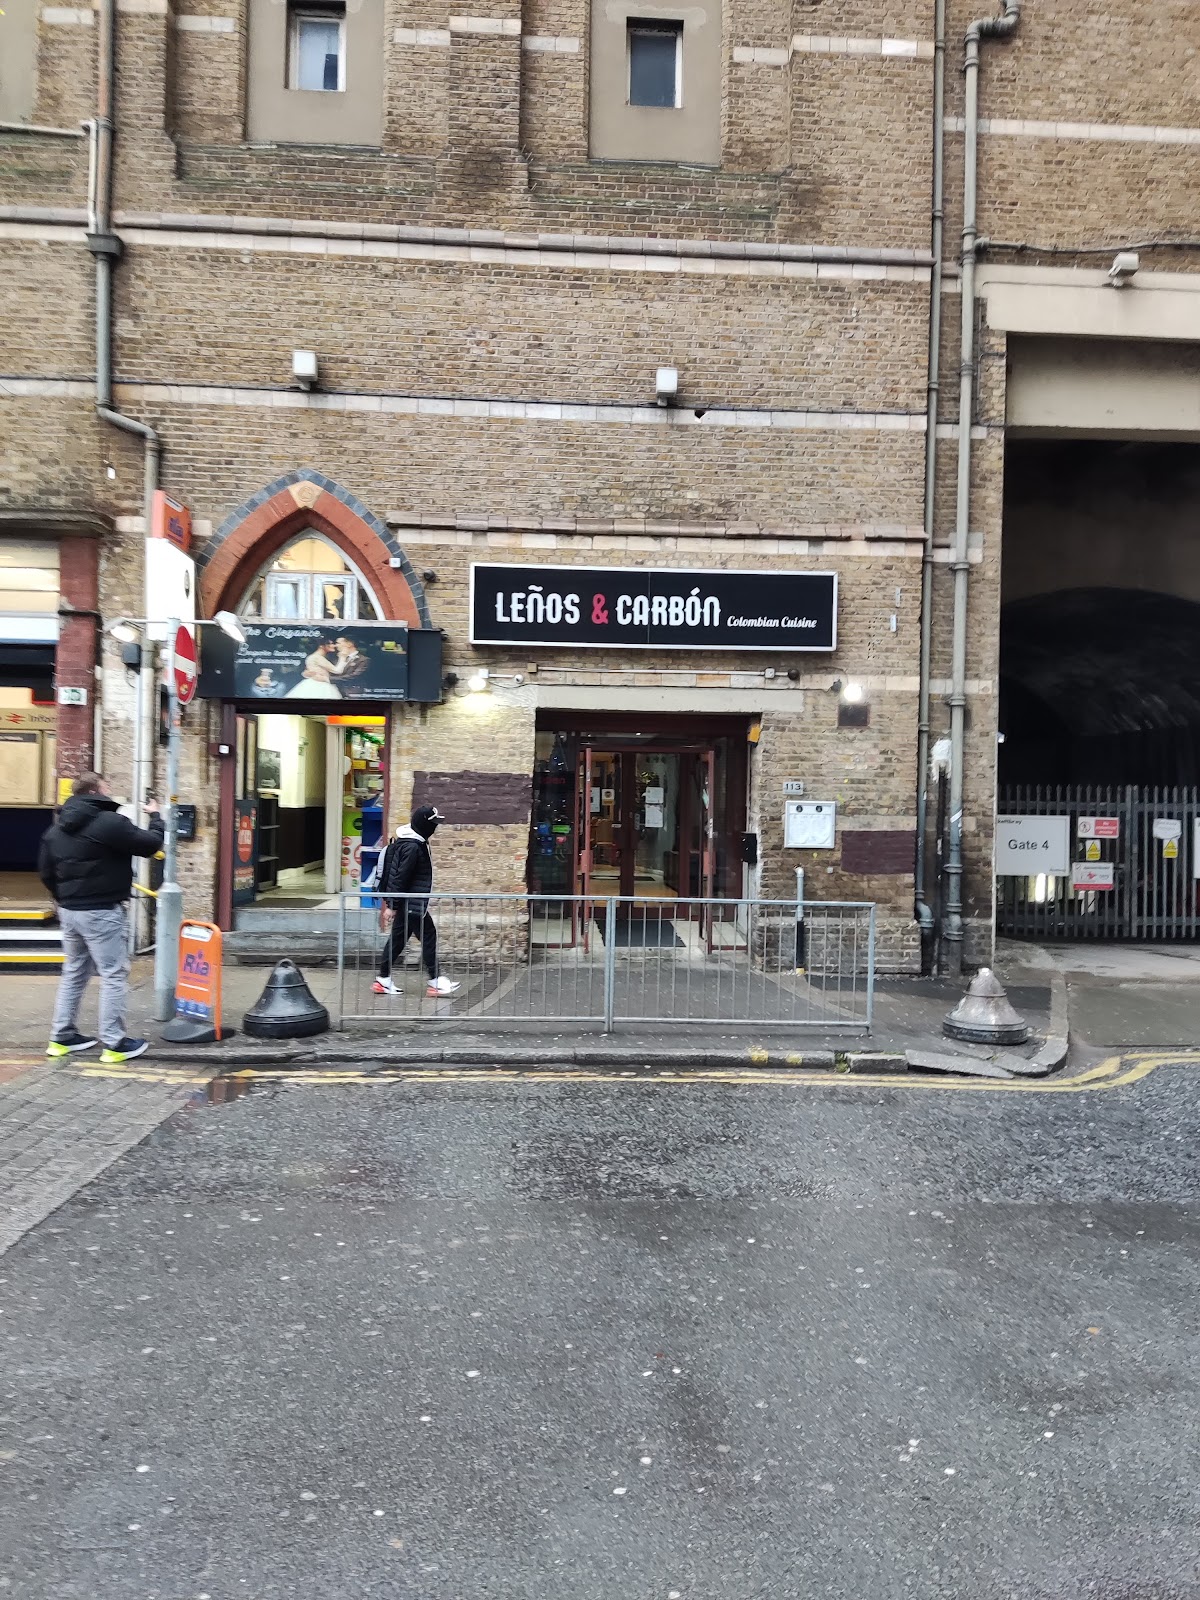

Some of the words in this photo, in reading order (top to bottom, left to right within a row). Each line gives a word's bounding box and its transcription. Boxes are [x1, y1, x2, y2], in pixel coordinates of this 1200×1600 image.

[495, 584, 581, 625] LEÑOS
[591, 593, 609, 625] &
[615, 586, 722, 627] CARBÓN
[726, 615, 780, 628] Colombian
[780, 616, 818, 629] Cuisine
[1008, 839, 1038, 850] Gate
[1041, 840, 1050, 850] 4
[183, 949, 210, 977] Ria
